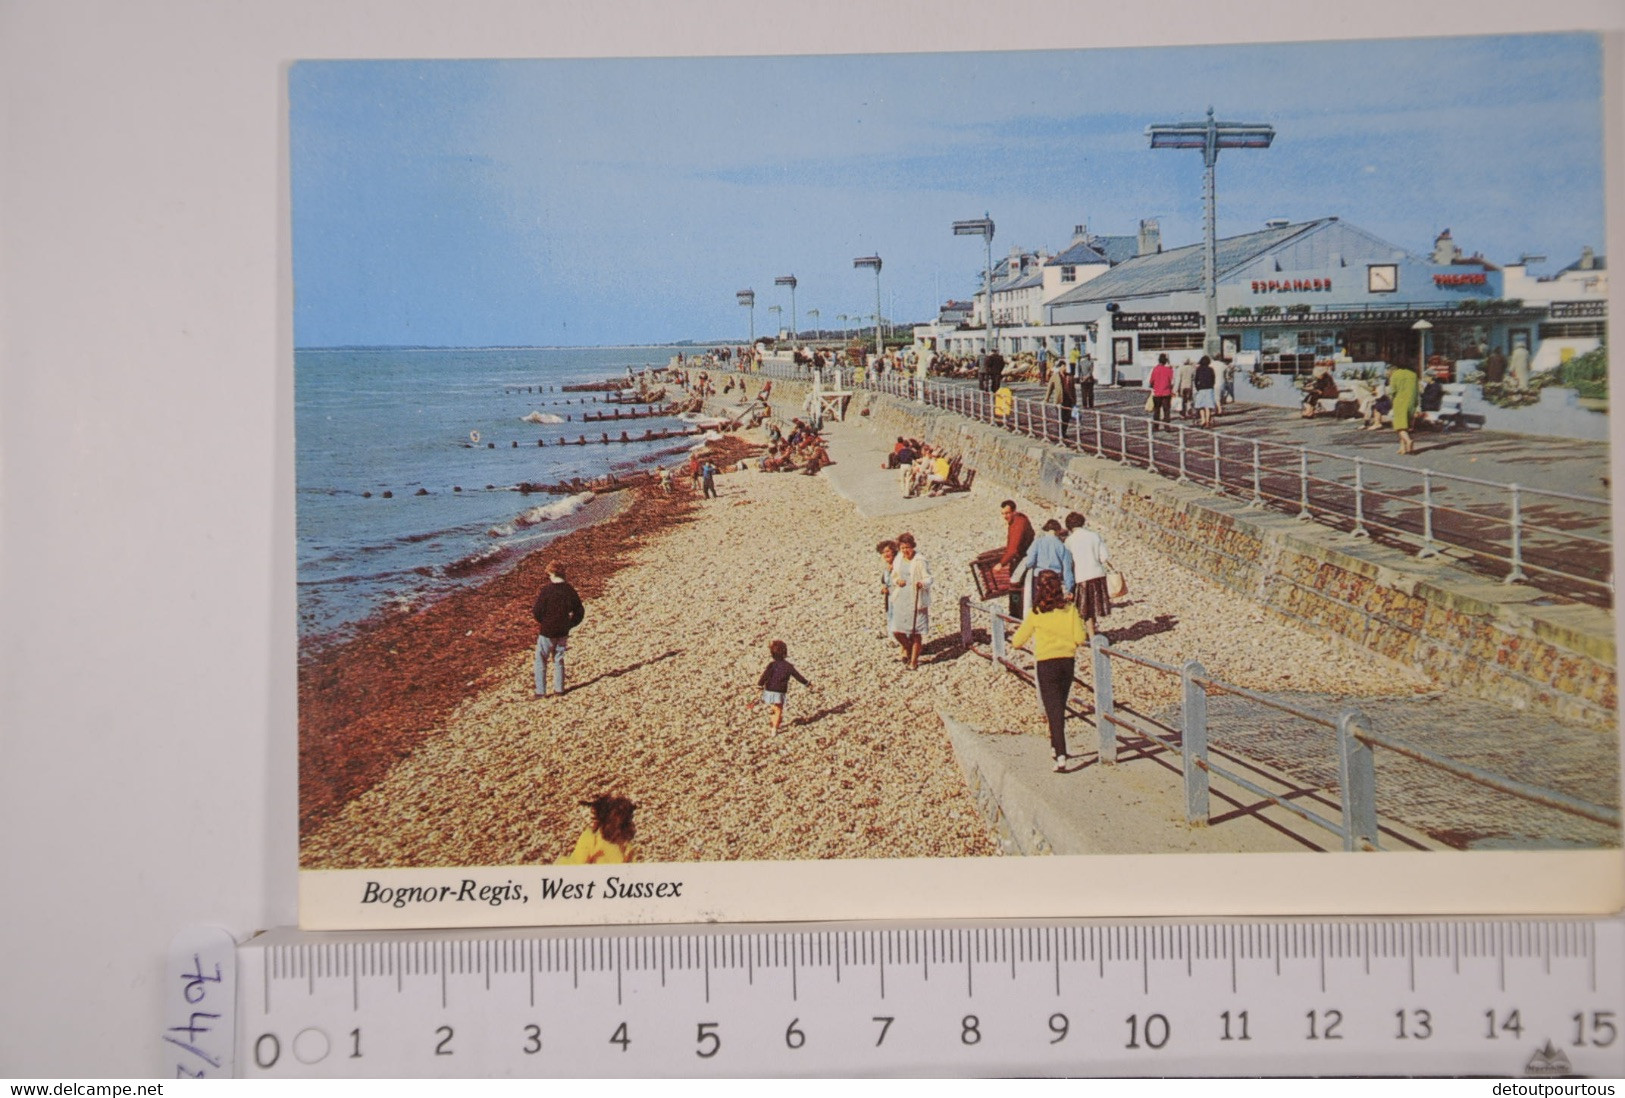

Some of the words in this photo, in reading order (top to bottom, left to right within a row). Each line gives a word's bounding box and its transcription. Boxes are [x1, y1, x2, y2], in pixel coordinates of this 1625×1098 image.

[1251, 278, 1332, 291] ESPLANADE
[361, 879, 529, 908] Bognor-Regis,
[541, 877, 596, 900] West
[603, 876, 684, 899] Sussex
[253, 1032, 282, 1070] 0
[349, 1027, 364, 1059] 1
[434, 1024, 455, 1057] 2
[522, 1023, 543, 1055] 3
[608, 1021, 632, 1053] 4
[695, 1021, 722, 1060] 5
[785, 1017, 807, 1050] 6
[871, 1016, 896, 1048] 7
[960, 1013, 982, 1046] 8
[1048, 1011, 1070, 1045] 9
[1124, 1012, 1172, 1050] 10
[1219, 1009, 1252, 1041] 11
[1305, 1009, 1344, 1041] 12
[1394, 1008, 1433, 1040] 13
[1484, 1007, 1524, 1040] 14
[1572, 1011, 1618, 1049] 15
